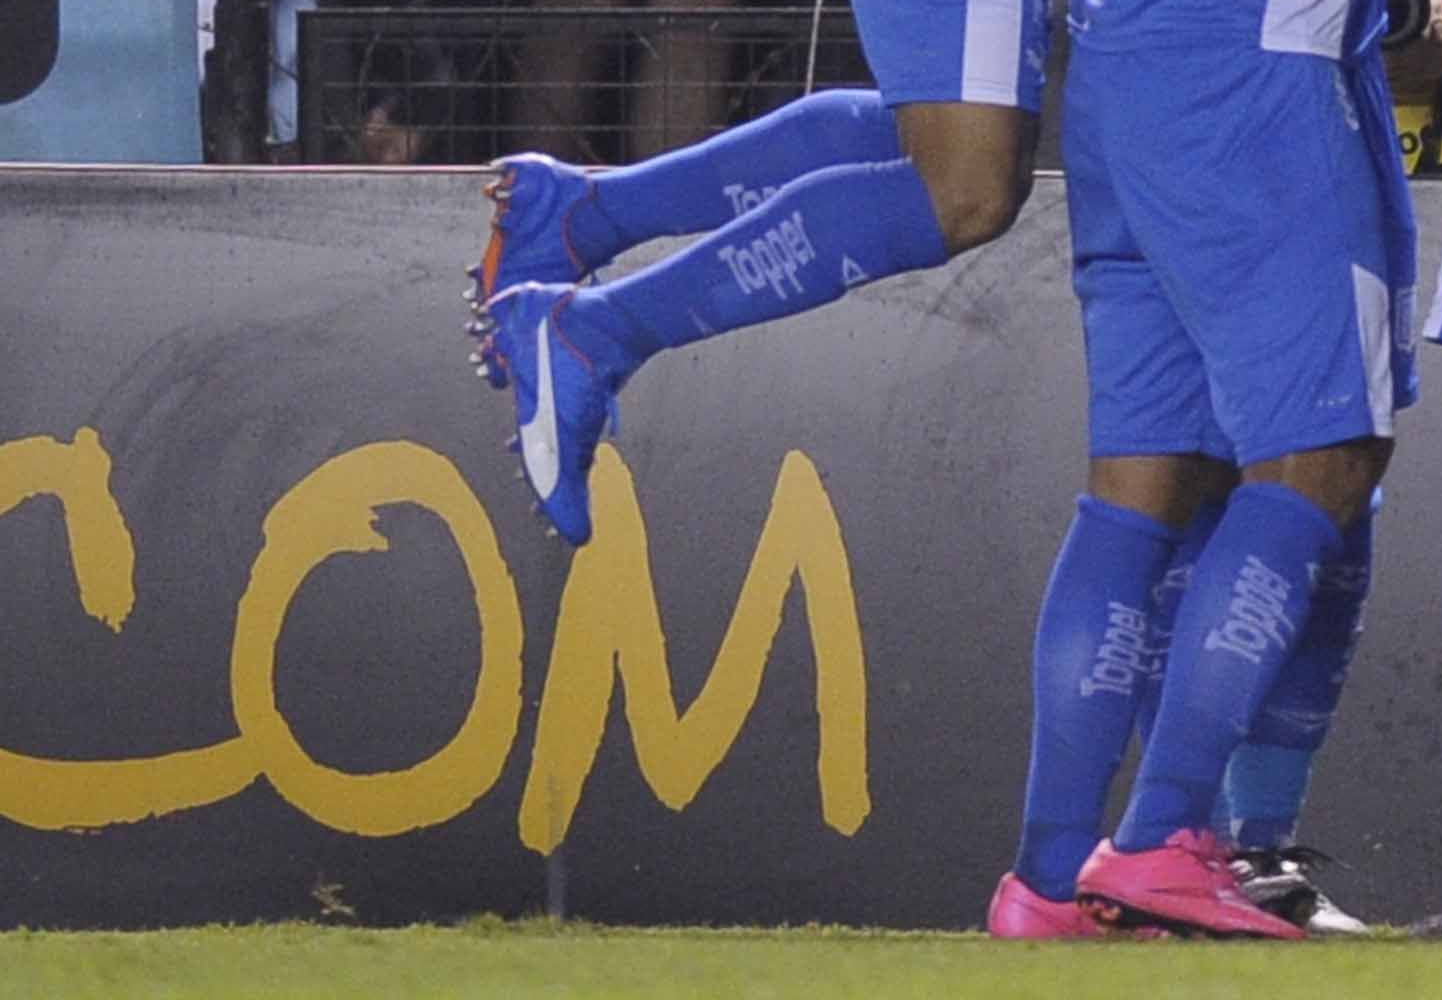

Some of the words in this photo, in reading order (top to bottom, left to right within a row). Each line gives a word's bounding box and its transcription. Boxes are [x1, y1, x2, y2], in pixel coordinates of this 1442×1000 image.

[717, 210, 816, 300] Topper
[1079, 600, 1148, 697] Topper
[1203, 553, 1296, 665] Topper
